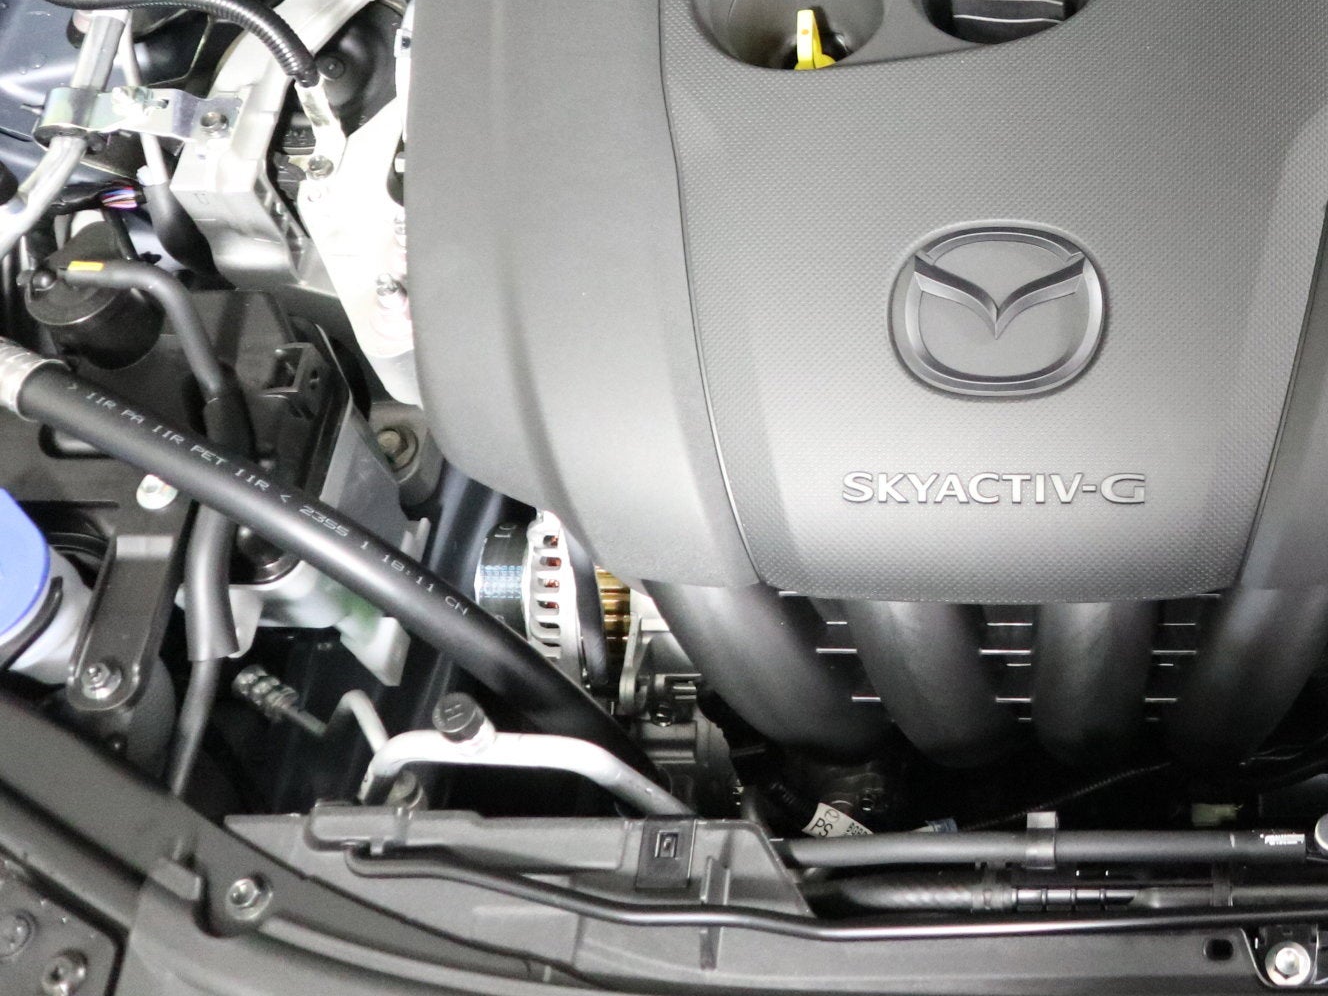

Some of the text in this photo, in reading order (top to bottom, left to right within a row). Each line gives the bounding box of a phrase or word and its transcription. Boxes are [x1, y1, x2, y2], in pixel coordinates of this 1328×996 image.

[842, 471, 1146, 505] SKYACTIV-G
[120, 409, 146, 425] PA
[189, 444, 231, 466] PET
[299, 505, 351, 538] 2355
[444, 595, 470, 617] CN
[809, 817, 834, 838] PS
